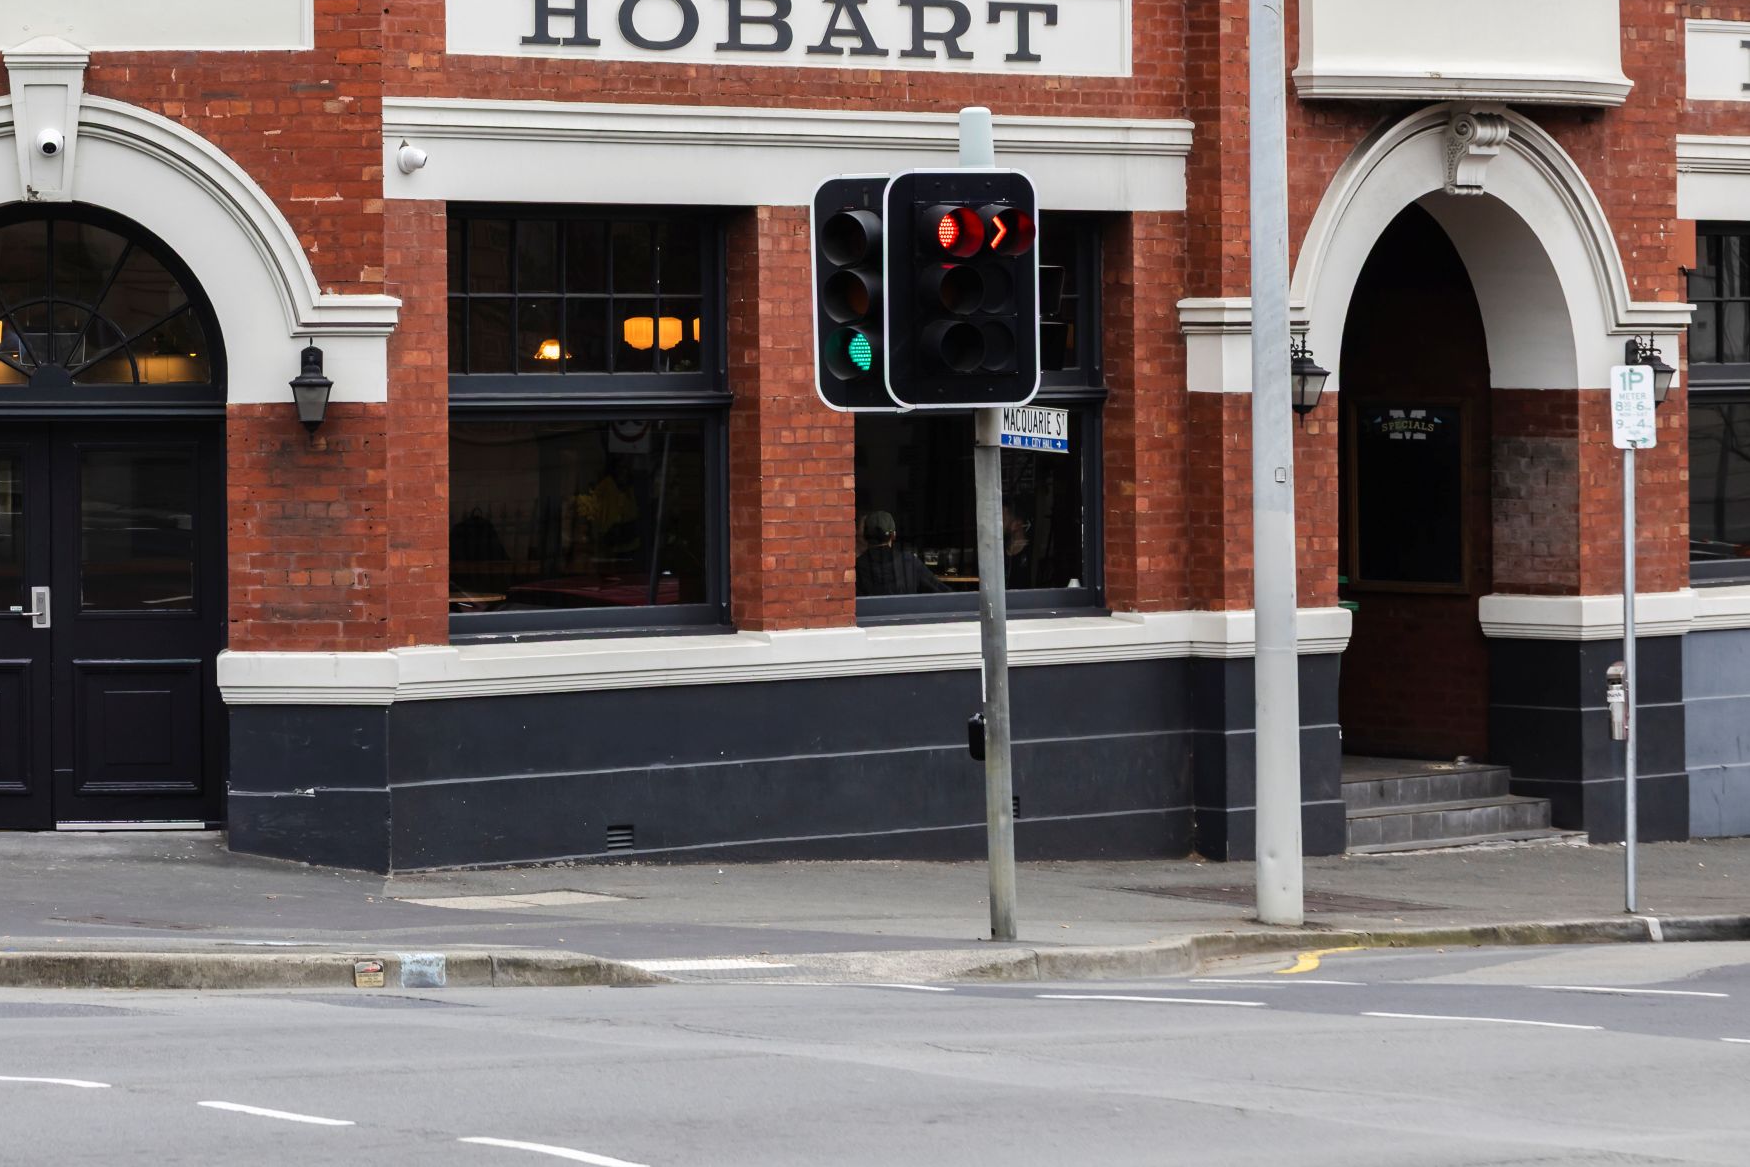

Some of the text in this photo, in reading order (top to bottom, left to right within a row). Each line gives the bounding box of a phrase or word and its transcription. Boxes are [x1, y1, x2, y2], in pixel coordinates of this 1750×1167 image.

[1619, 371, 1644, 391] 1P
[1619, 392, 1647, 400] METER
[1003, 408, 1065, 436] MACQUARIE ST
[1382, 421, 1434, 431] SPECIALS
